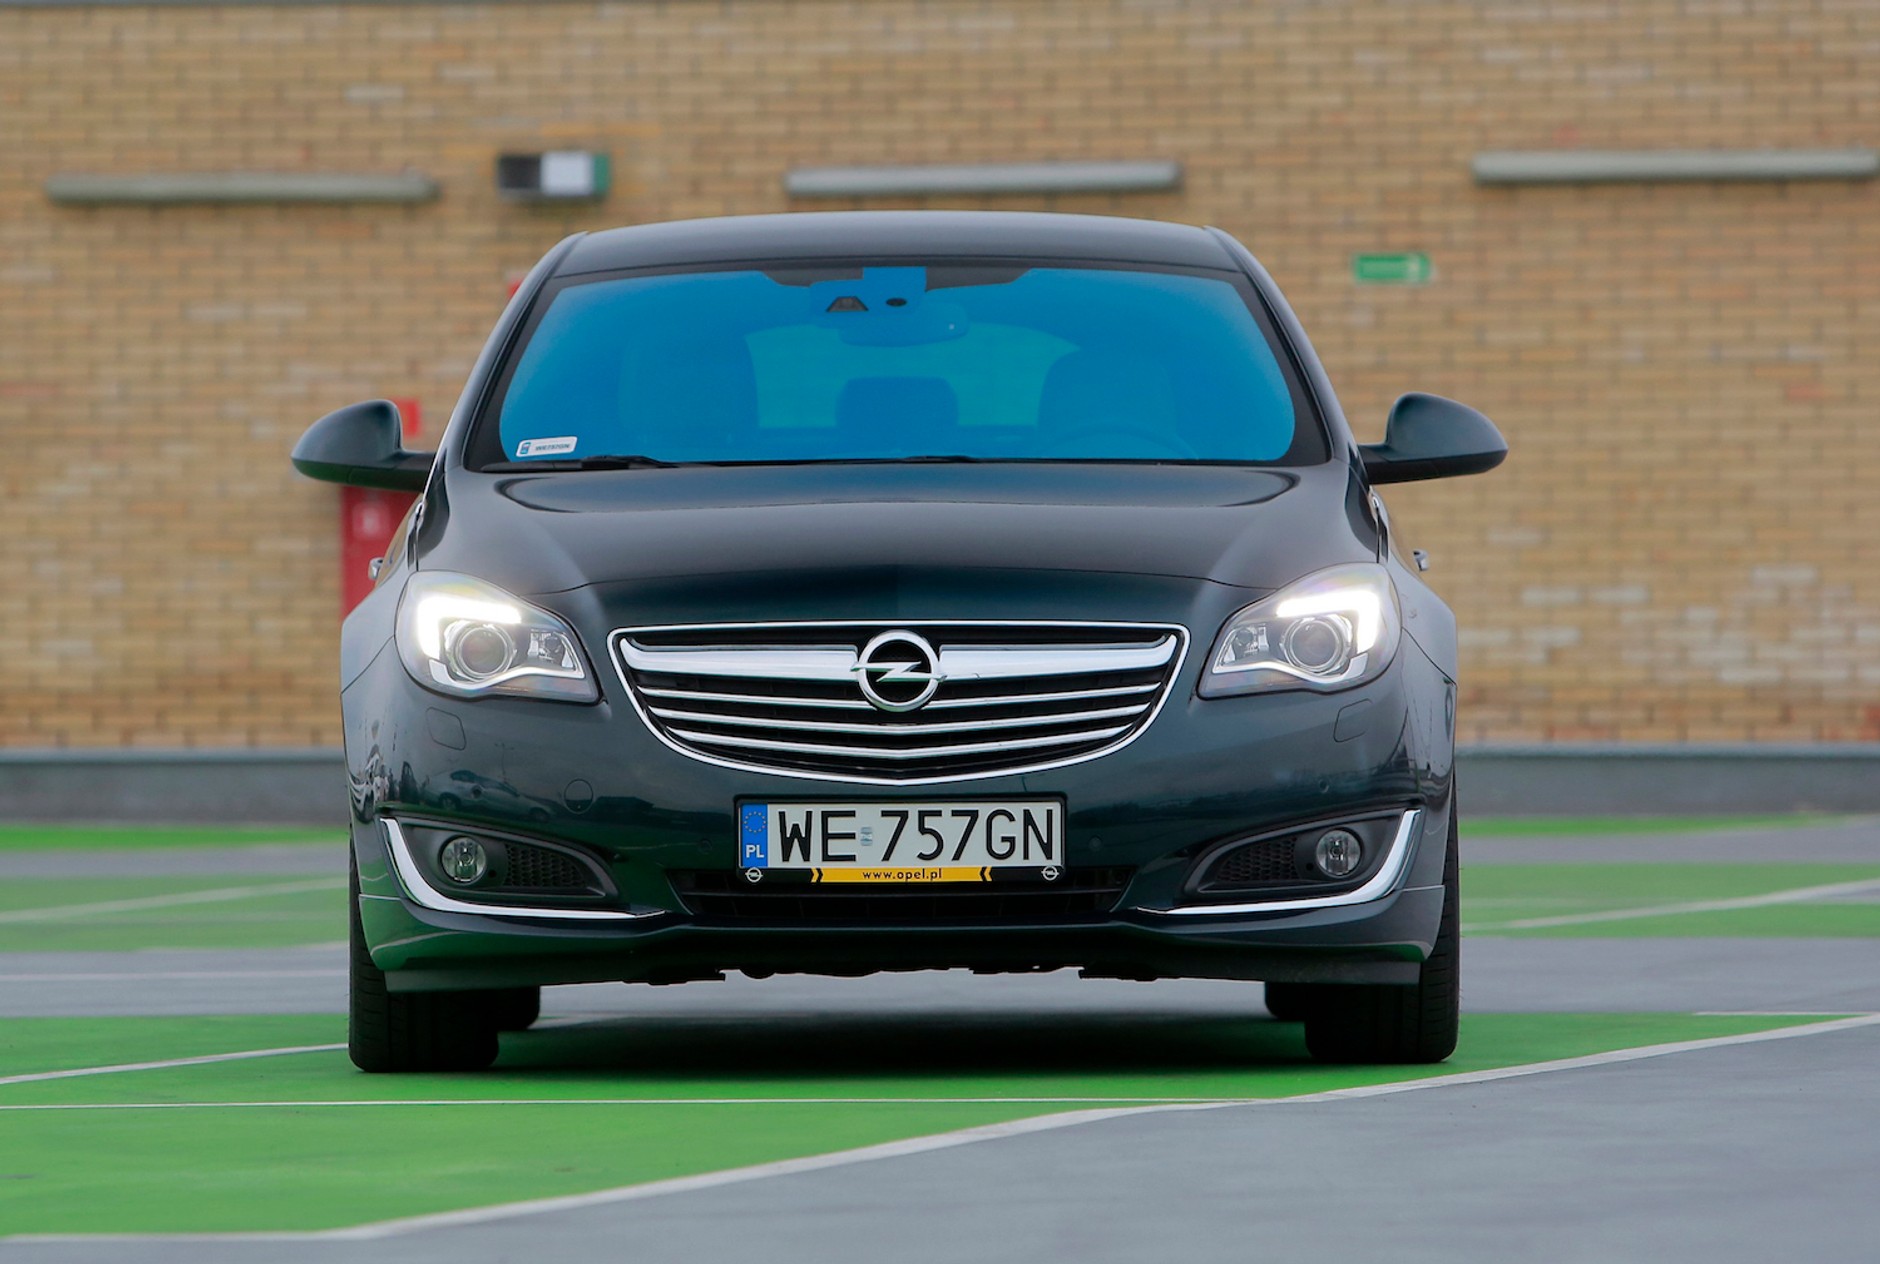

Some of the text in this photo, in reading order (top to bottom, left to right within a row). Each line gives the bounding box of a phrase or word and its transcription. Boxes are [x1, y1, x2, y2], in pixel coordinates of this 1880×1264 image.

[778, 808, 1052, 862] WE 757GN
[745, 844, 765, 858] PL
[862, 867, 942, 882] www.opel.pl
